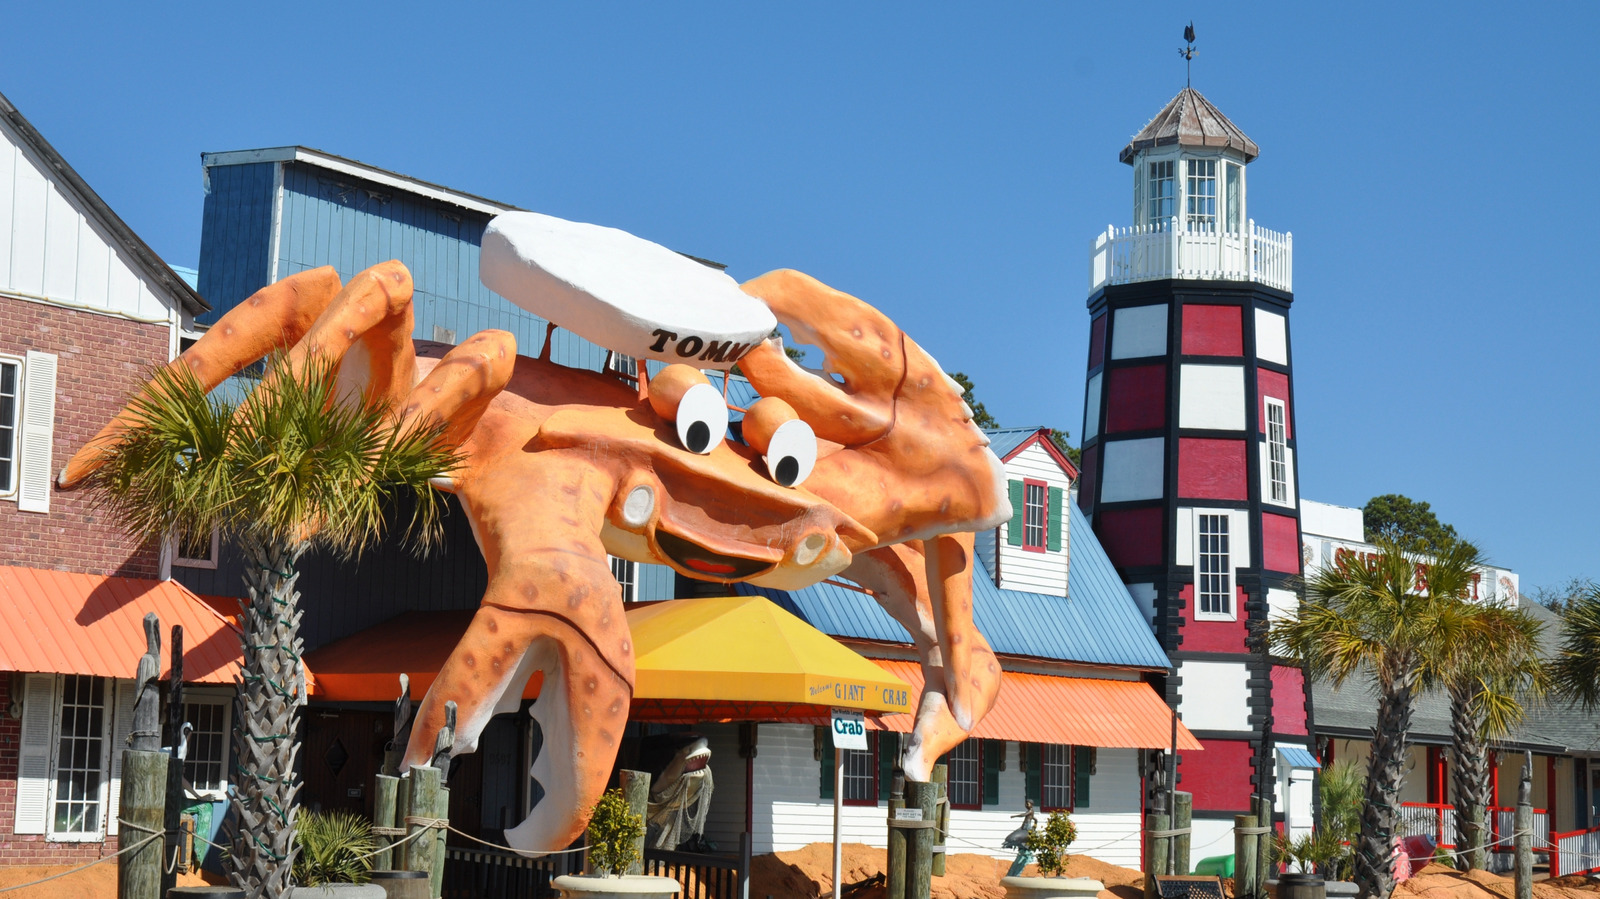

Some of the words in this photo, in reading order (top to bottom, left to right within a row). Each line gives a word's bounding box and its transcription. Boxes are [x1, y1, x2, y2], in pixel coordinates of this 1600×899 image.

[649, 328, 752, 363] TOMM
[834, 683, 866, 701] GIANT
[882, 688, 907, 706] CRAB
[834, 717, 863, 736] Crab
